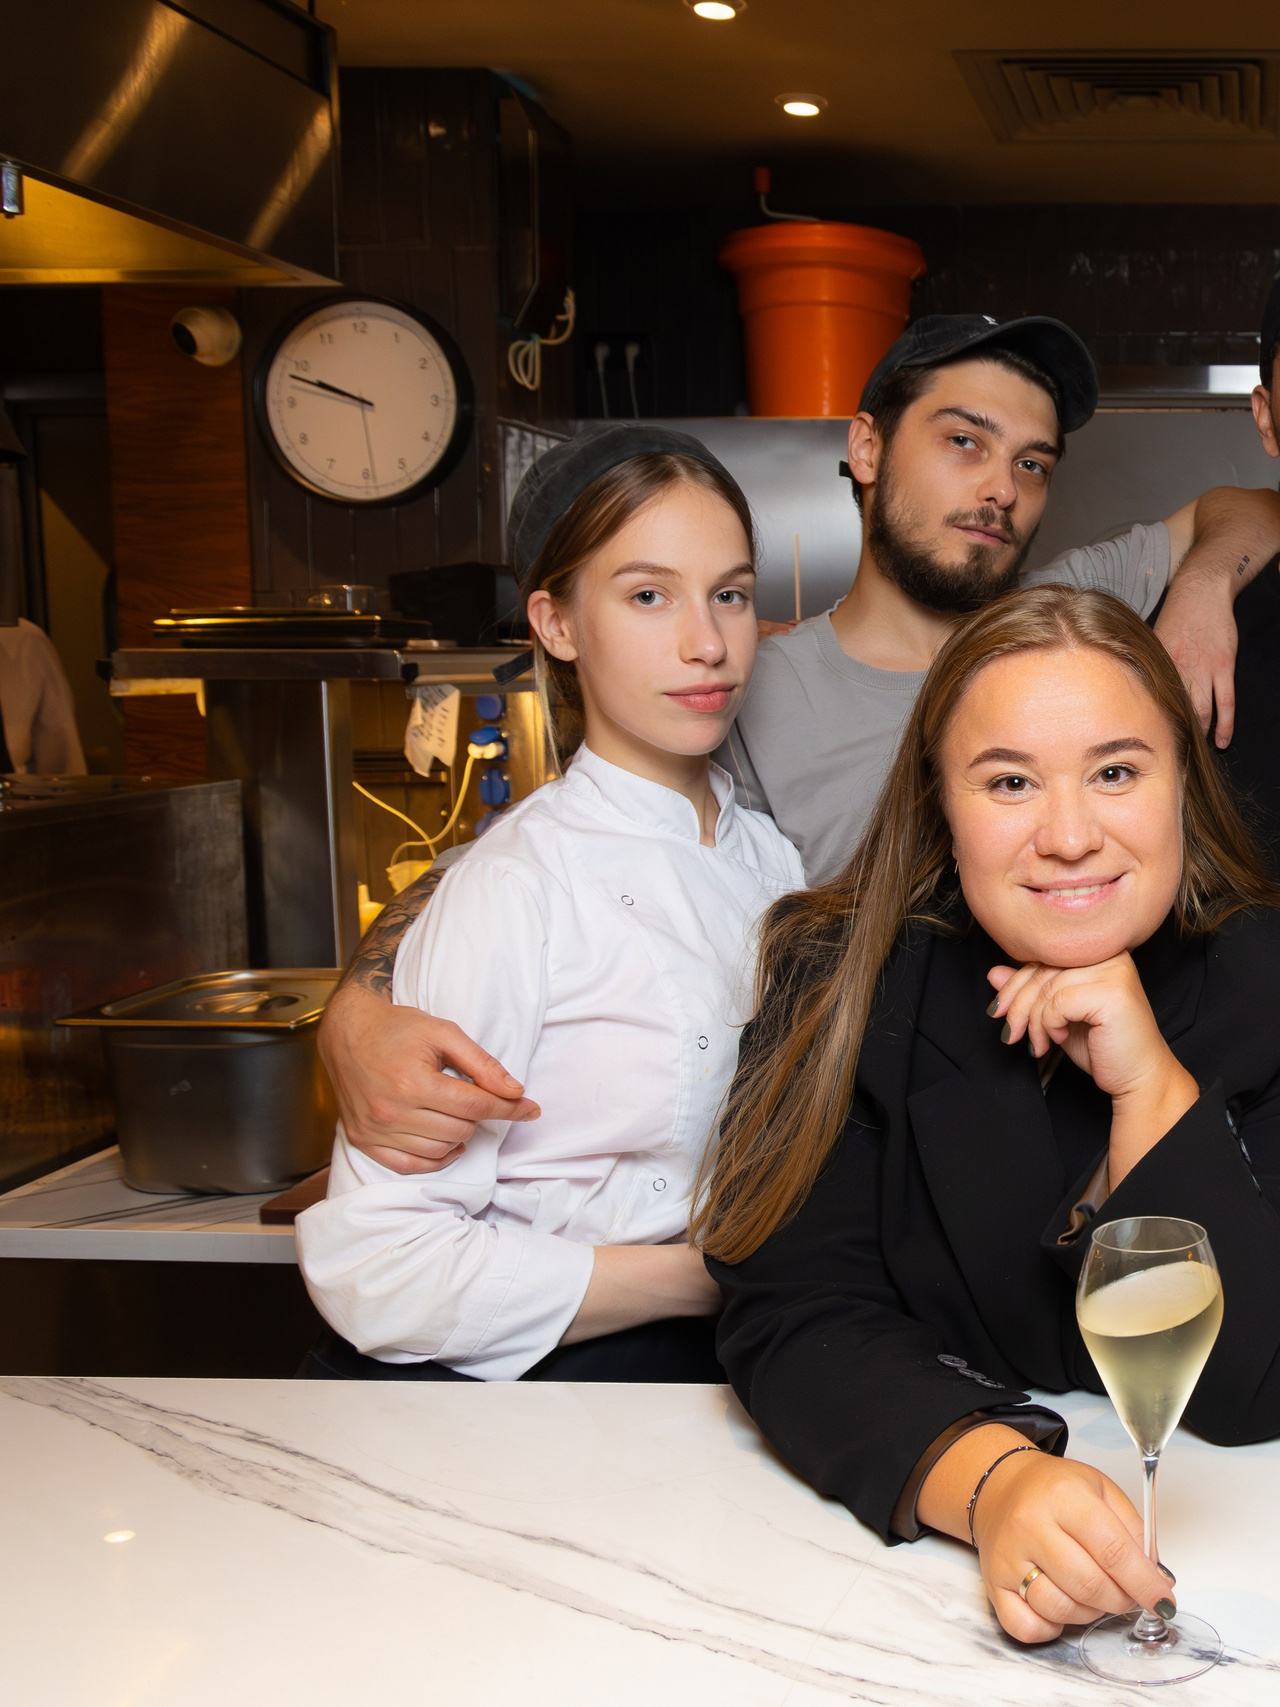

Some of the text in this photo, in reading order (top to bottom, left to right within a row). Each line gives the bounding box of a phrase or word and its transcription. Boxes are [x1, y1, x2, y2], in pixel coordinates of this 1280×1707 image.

[353, 321, 368, 334] 12
[294, 360, 310, 371] 10
[419, 357, 428, 370] 2
[288, 396, 297, 408] 9
[431, 394, 439, 406] 3
[299, 432, 308, 444] 8
[421, 431, 430, 442] 4
[327, 458, 336, 470] 7
[398, 458, 406, 470] 5
[362, 468, 370, 480] 6
